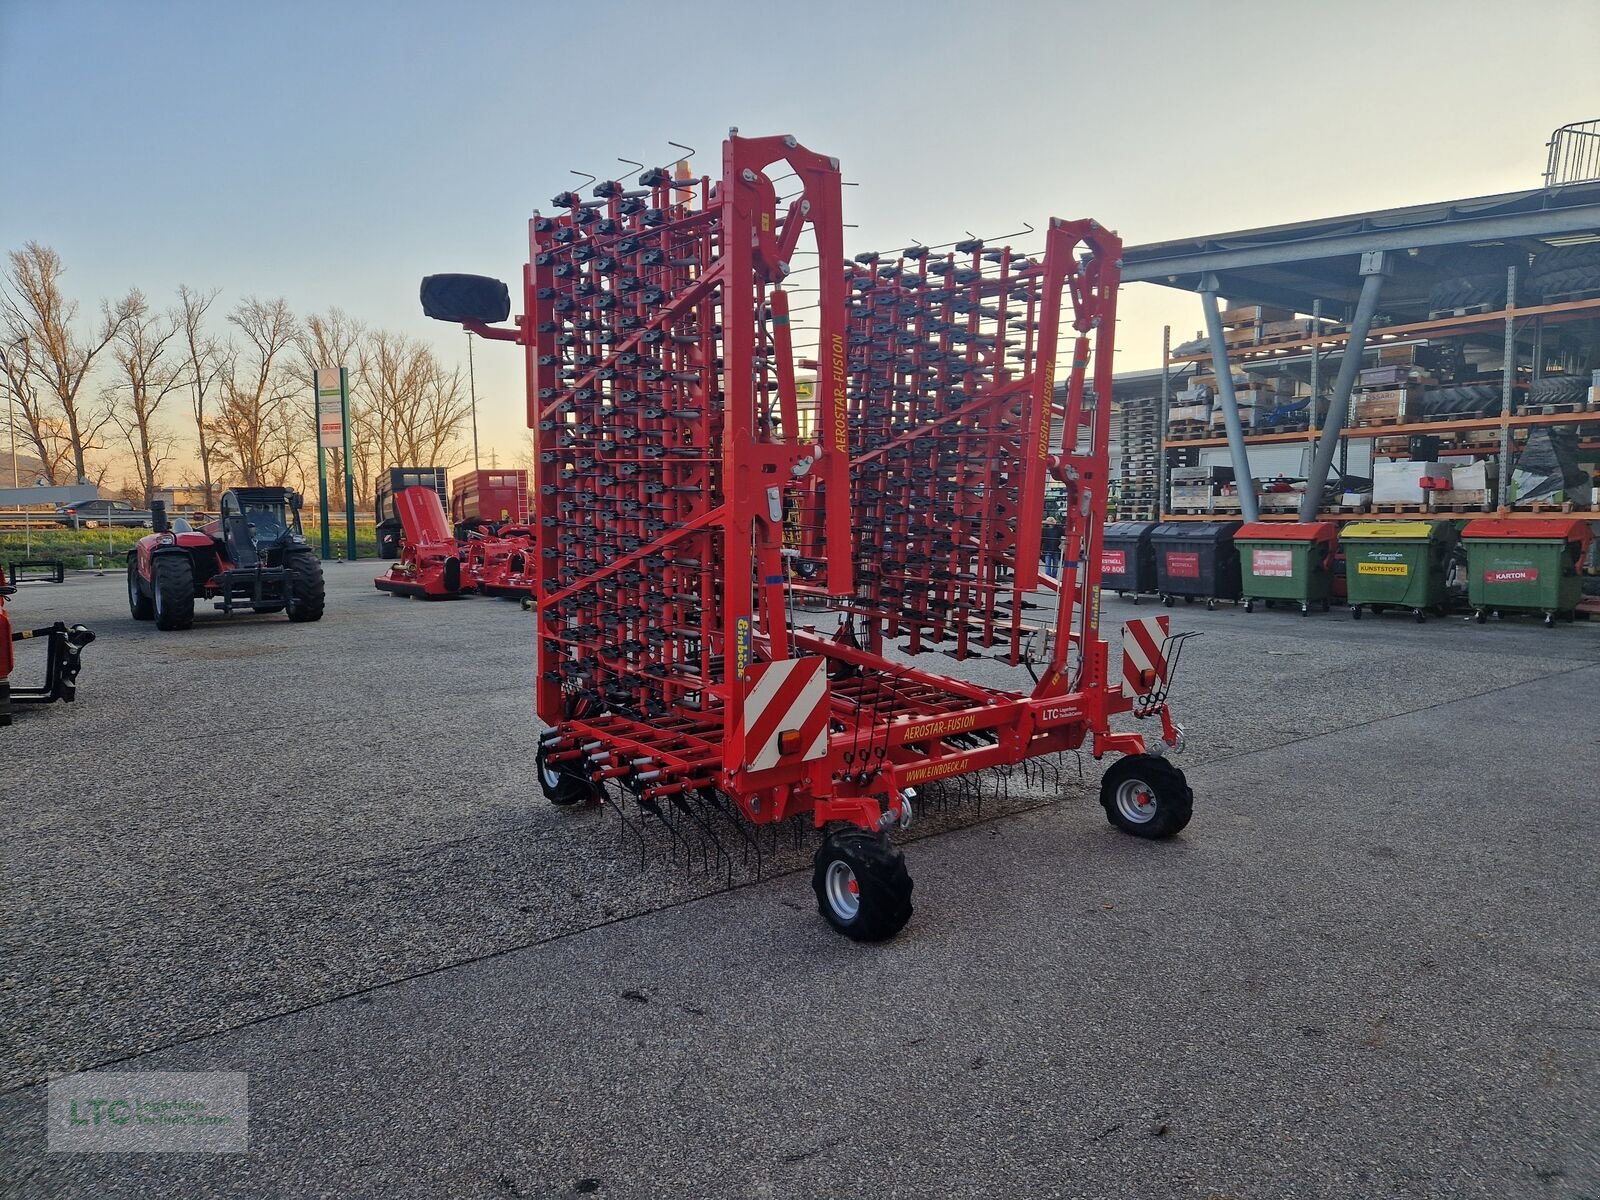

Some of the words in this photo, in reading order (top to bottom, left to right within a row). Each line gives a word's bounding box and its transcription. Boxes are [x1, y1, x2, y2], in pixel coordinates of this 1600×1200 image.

[832, 333, 846, 453] AEROSTAR-FUSION
[1038, 359, 1054, 461] AEROSTAR-FUSION
[1360, 565, 1405, 573] KUNSTSTOFFE
[1495, 572, 1526, 580] KARTON
[1042, 708, 1059, 720] LTC
[904, 714, 976, 741] AEROSTAR-FUSION
[906, 759, 969, 782] WWW.EINBOECK.AT
